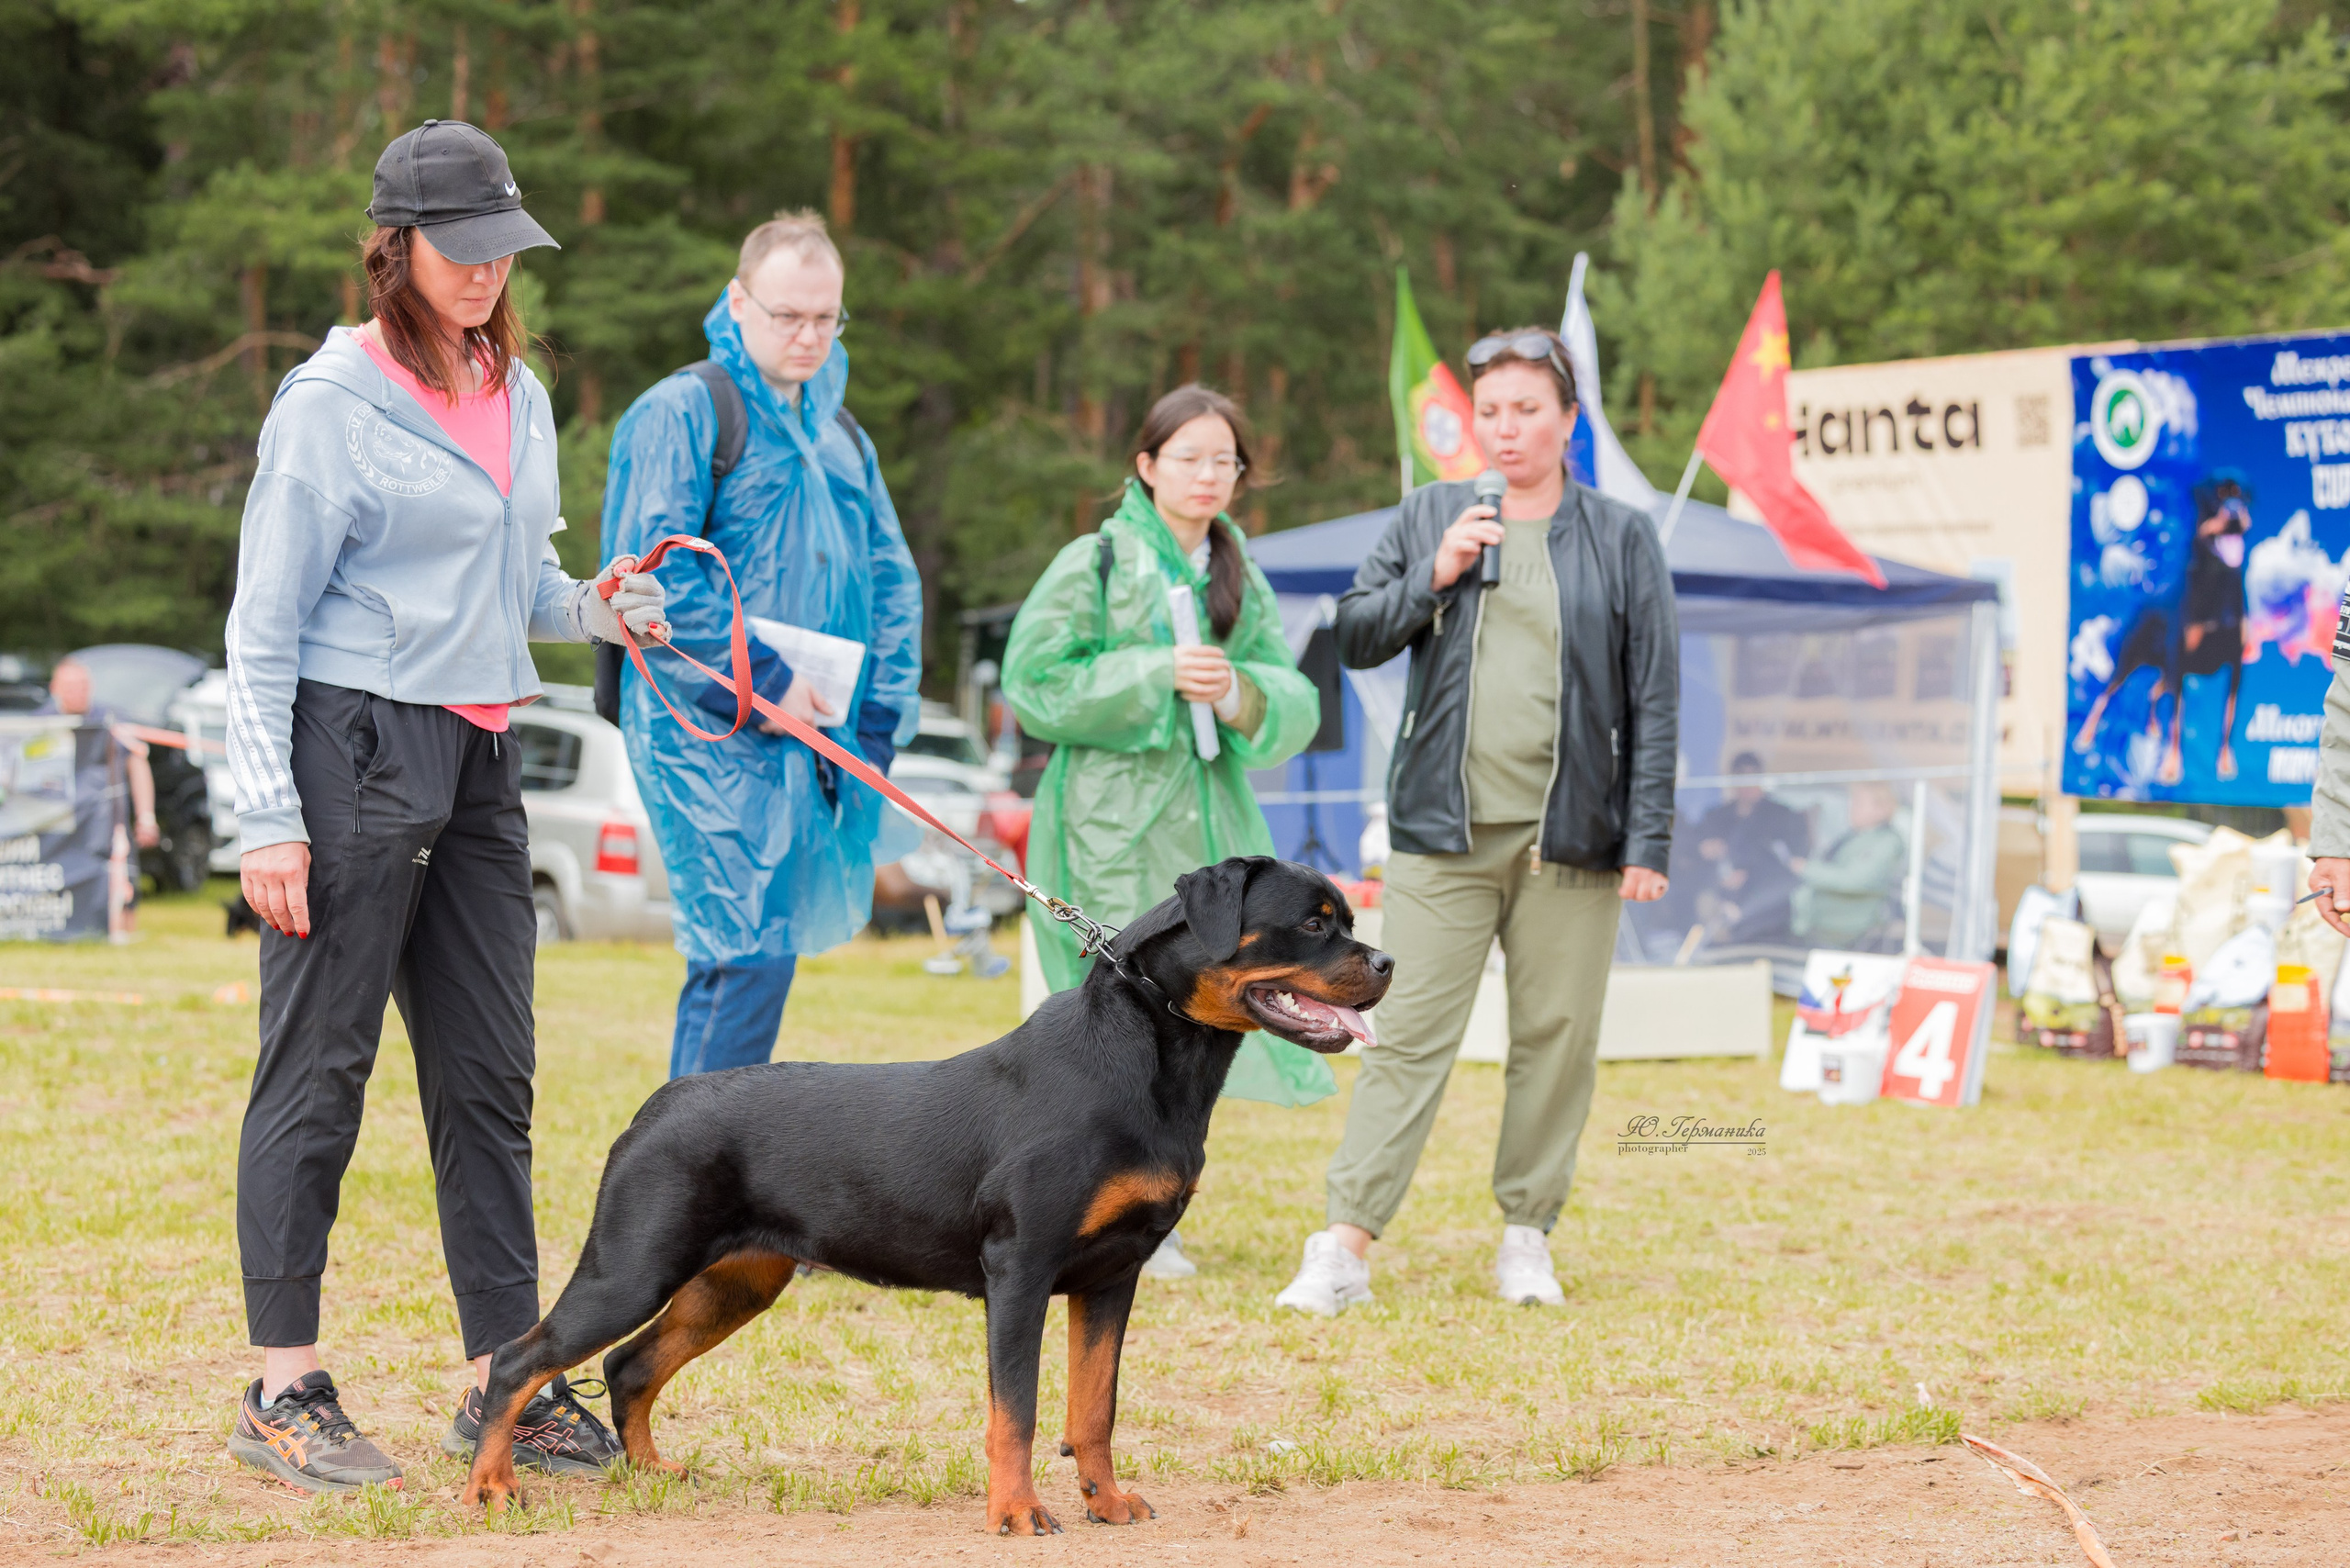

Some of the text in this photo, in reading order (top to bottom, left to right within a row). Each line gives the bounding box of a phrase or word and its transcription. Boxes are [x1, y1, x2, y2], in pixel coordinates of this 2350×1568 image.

[1796, 395, 1980, 455] anta
[379, 468, 448, 494] ROTTWEILER
[1893, 1001, 1960, 1099] 4
